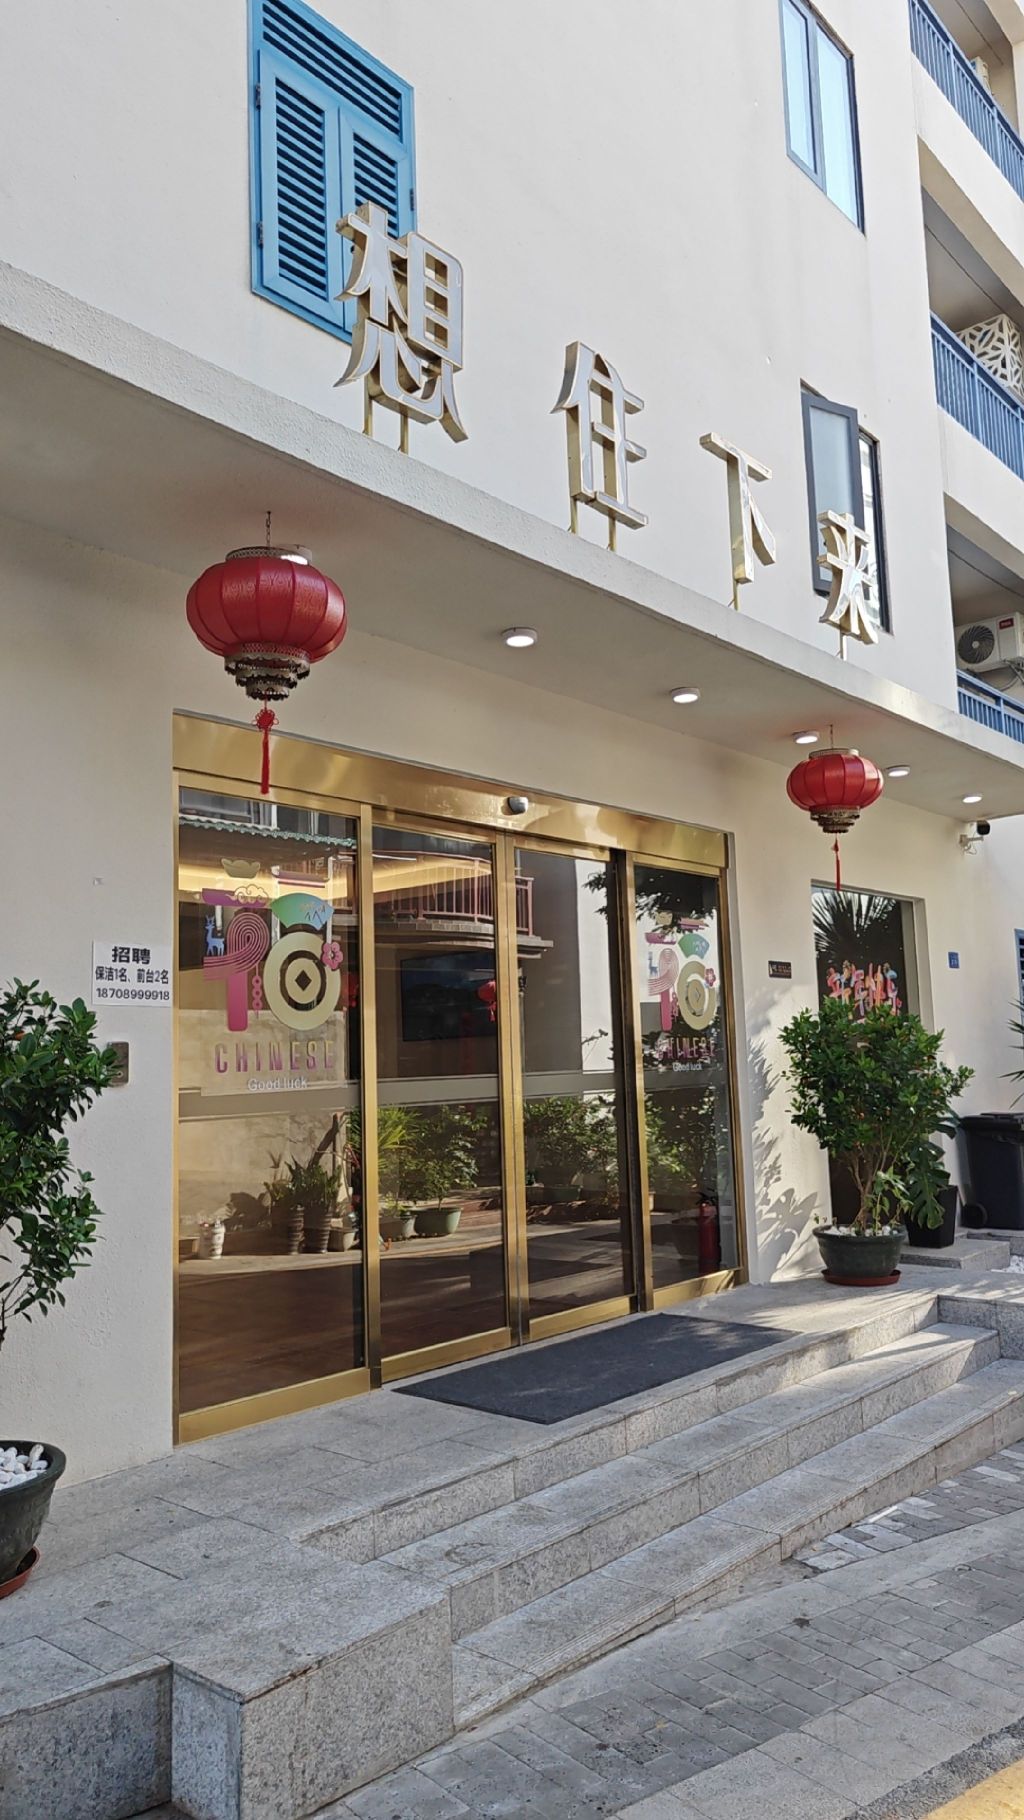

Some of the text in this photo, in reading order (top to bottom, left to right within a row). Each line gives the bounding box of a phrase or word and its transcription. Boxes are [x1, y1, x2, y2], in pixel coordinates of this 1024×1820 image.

[333, 200, 880, 645] 想住下来
[112, 946, 150, 965] 招聘
[96, 987, 170, 1001] 18708999918
[215, 1040, 334, 1074] CHINESE
[247, 1076, 308, 1091] Good luck
